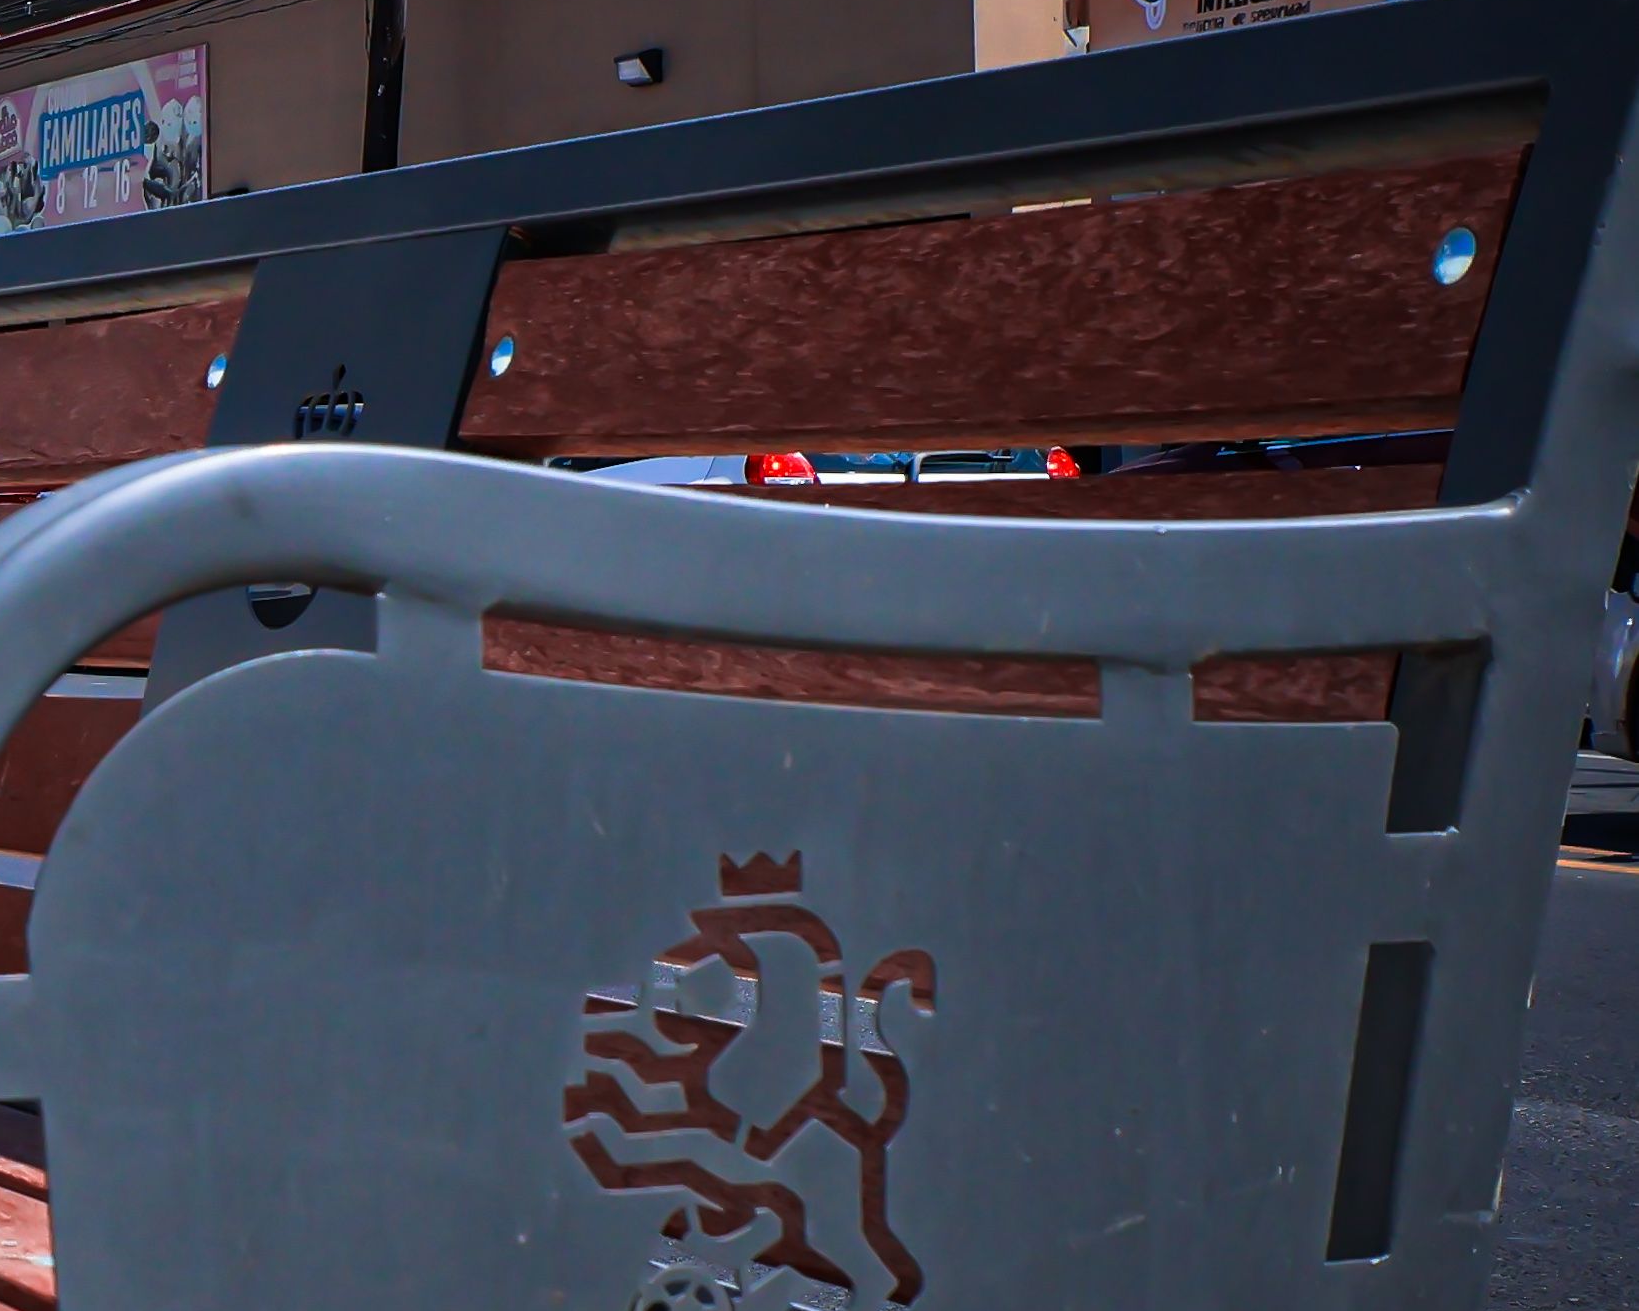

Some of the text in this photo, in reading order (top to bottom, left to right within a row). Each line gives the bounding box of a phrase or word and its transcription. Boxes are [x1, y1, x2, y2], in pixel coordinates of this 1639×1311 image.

[42, 97, 142, 169] FAMILIARES
[56, 158, 130, 214] 8 12 16
